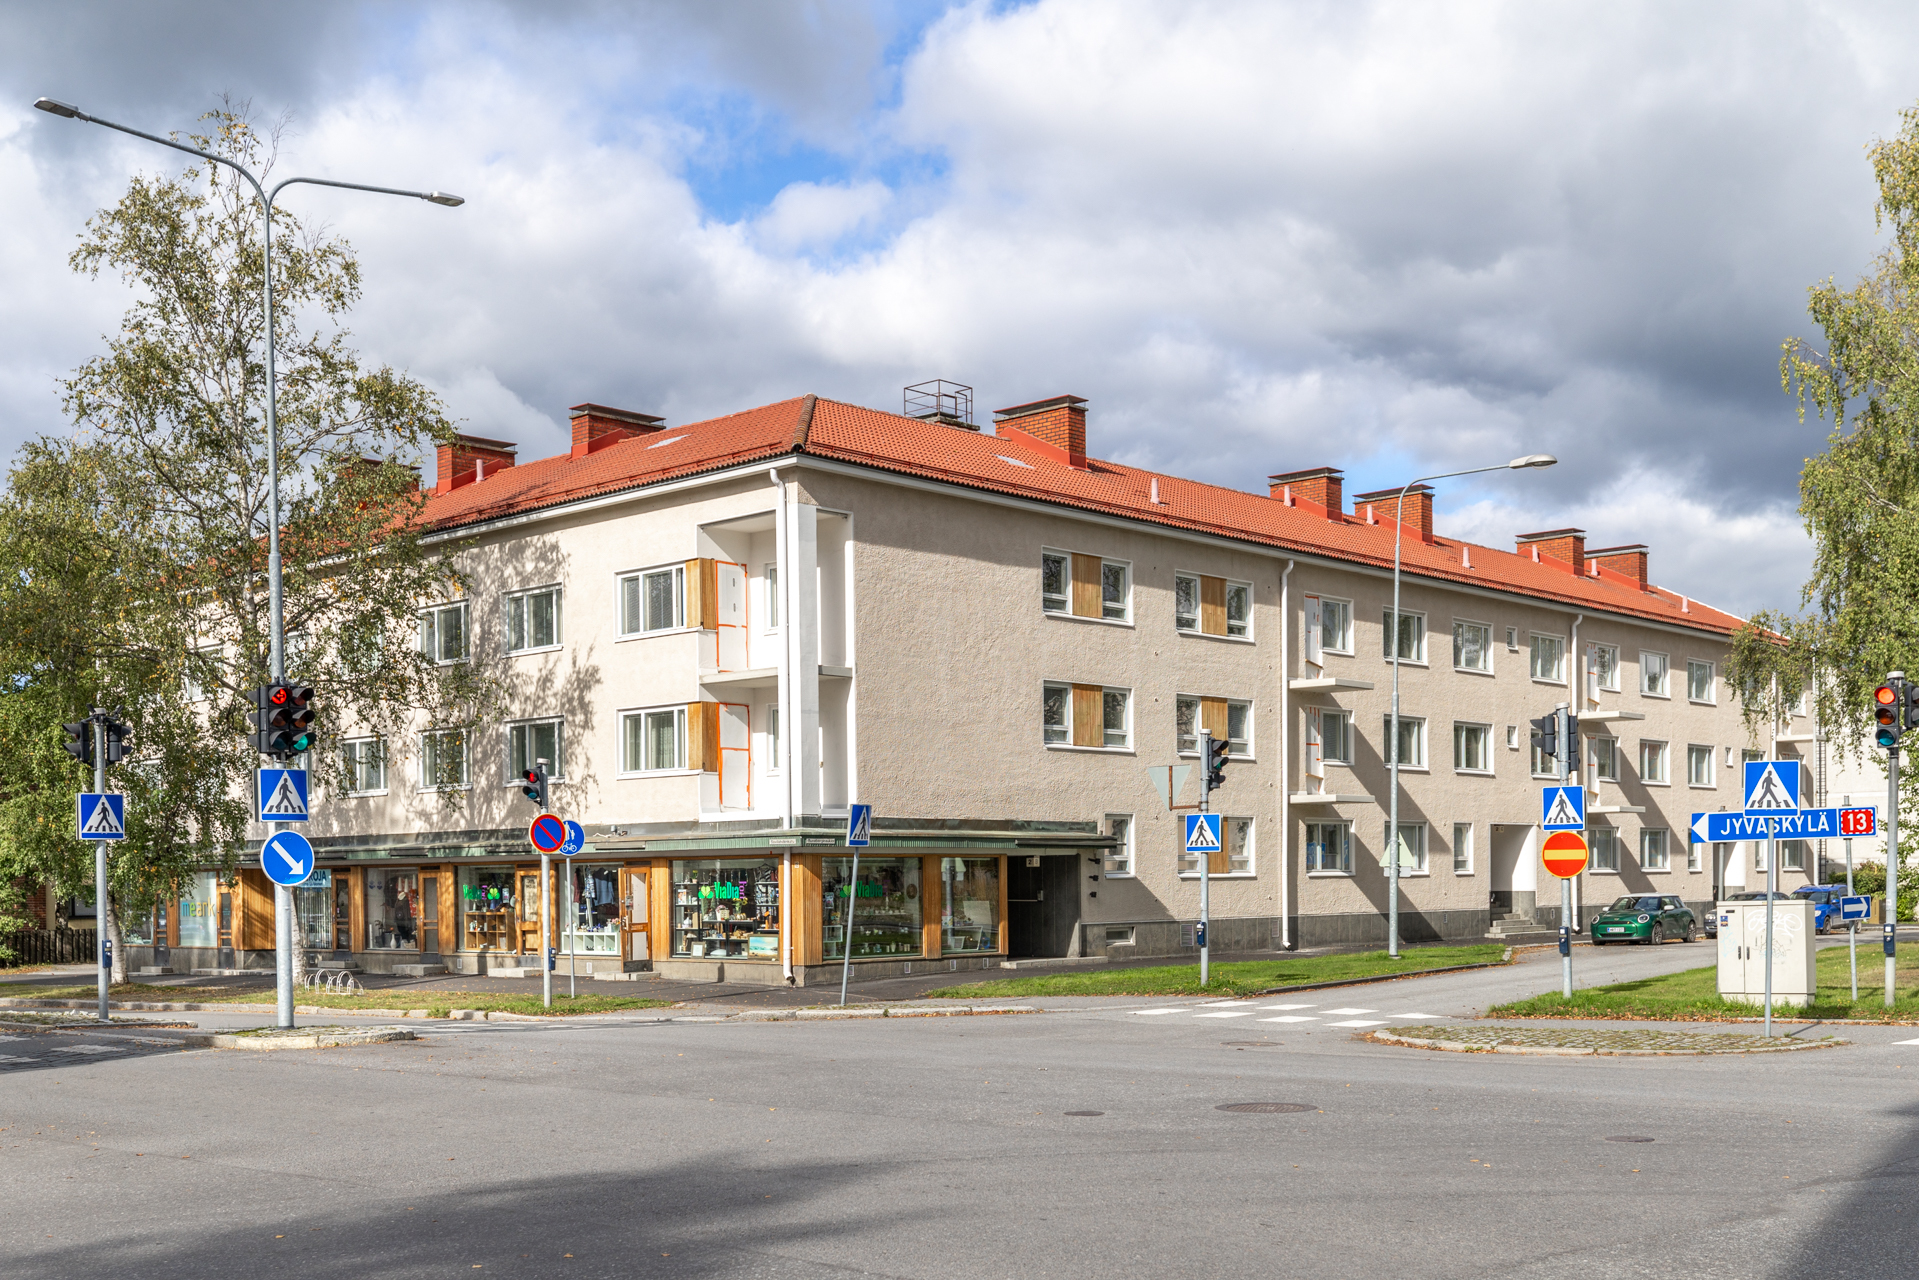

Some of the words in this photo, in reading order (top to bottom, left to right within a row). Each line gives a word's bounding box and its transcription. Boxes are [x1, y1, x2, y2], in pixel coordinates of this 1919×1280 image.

[1847, 813, 1867, 831] 13
[714, 881, 739, 899] ViaDia
[181, 897, 215, 917] meark
